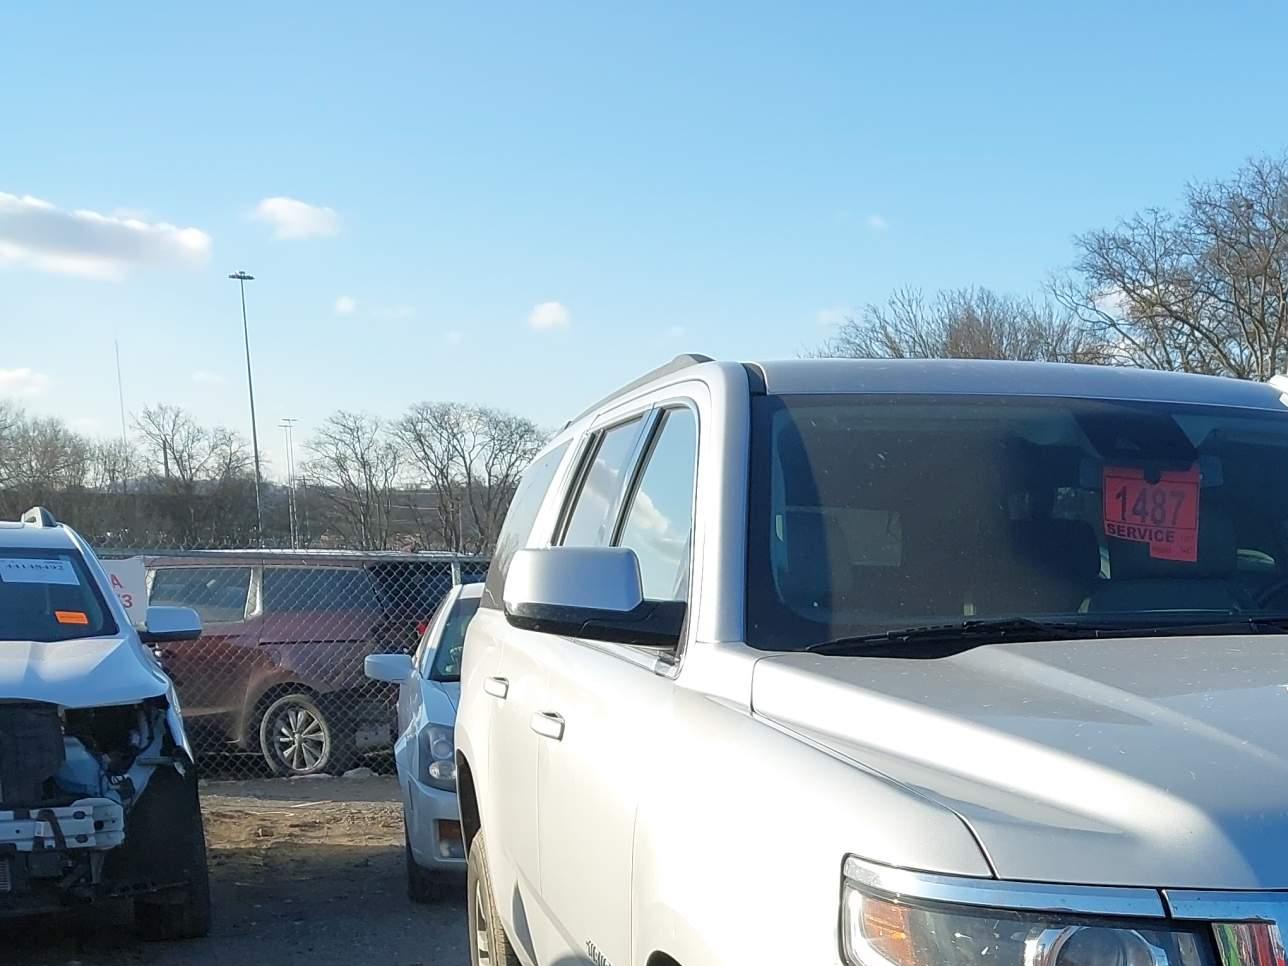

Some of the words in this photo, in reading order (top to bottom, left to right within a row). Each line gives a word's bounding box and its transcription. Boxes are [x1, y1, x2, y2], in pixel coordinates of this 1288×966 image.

[1115, 485, 1186, 527] 1487
[1105, 522, 1176, 543] SERVICE
[117, 593, 133, 608] 3
